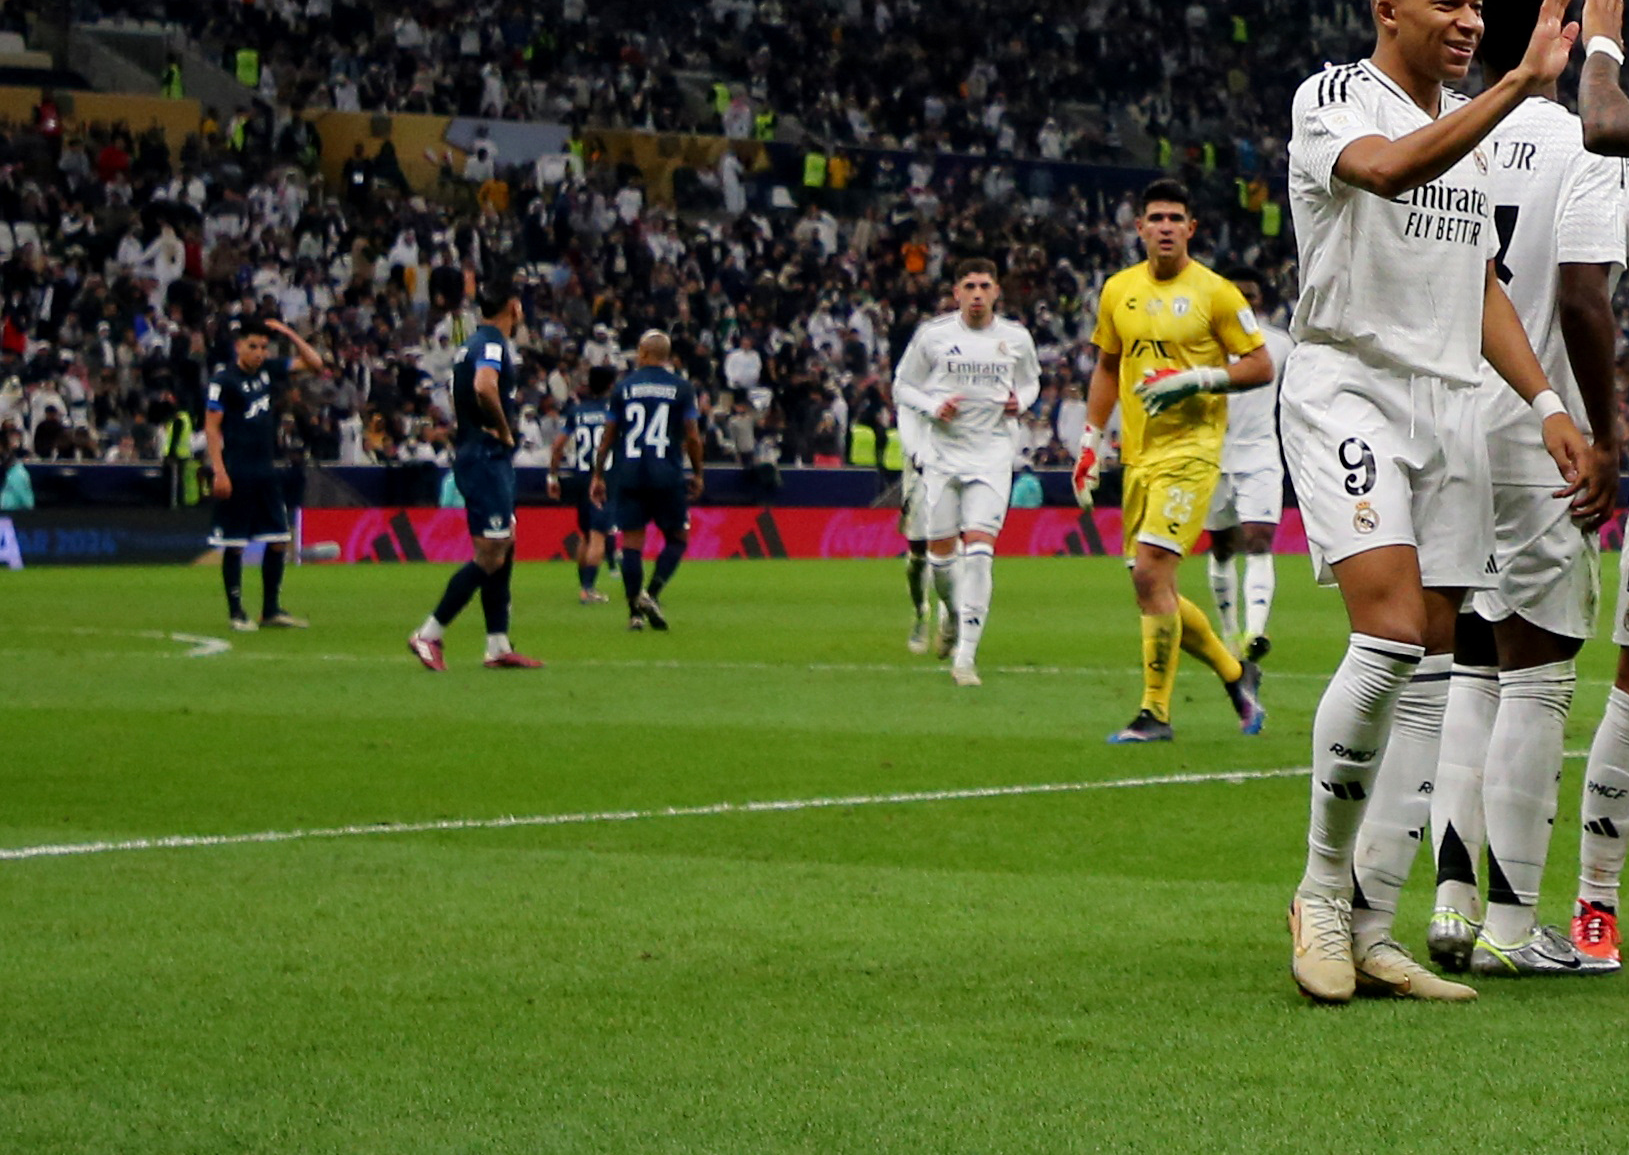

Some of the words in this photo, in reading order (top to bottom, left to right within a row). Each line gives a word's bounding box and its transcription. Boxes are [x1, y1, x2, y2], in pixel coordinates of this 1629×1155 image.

[1502, 142, 1537, 171] JR.
[1390, 179, 1489, 219] mirate
[1404, 211, 1433, 239] FLY
[624, 402, 671, 459] 24
[1338, 437, 1378, 496] 9
